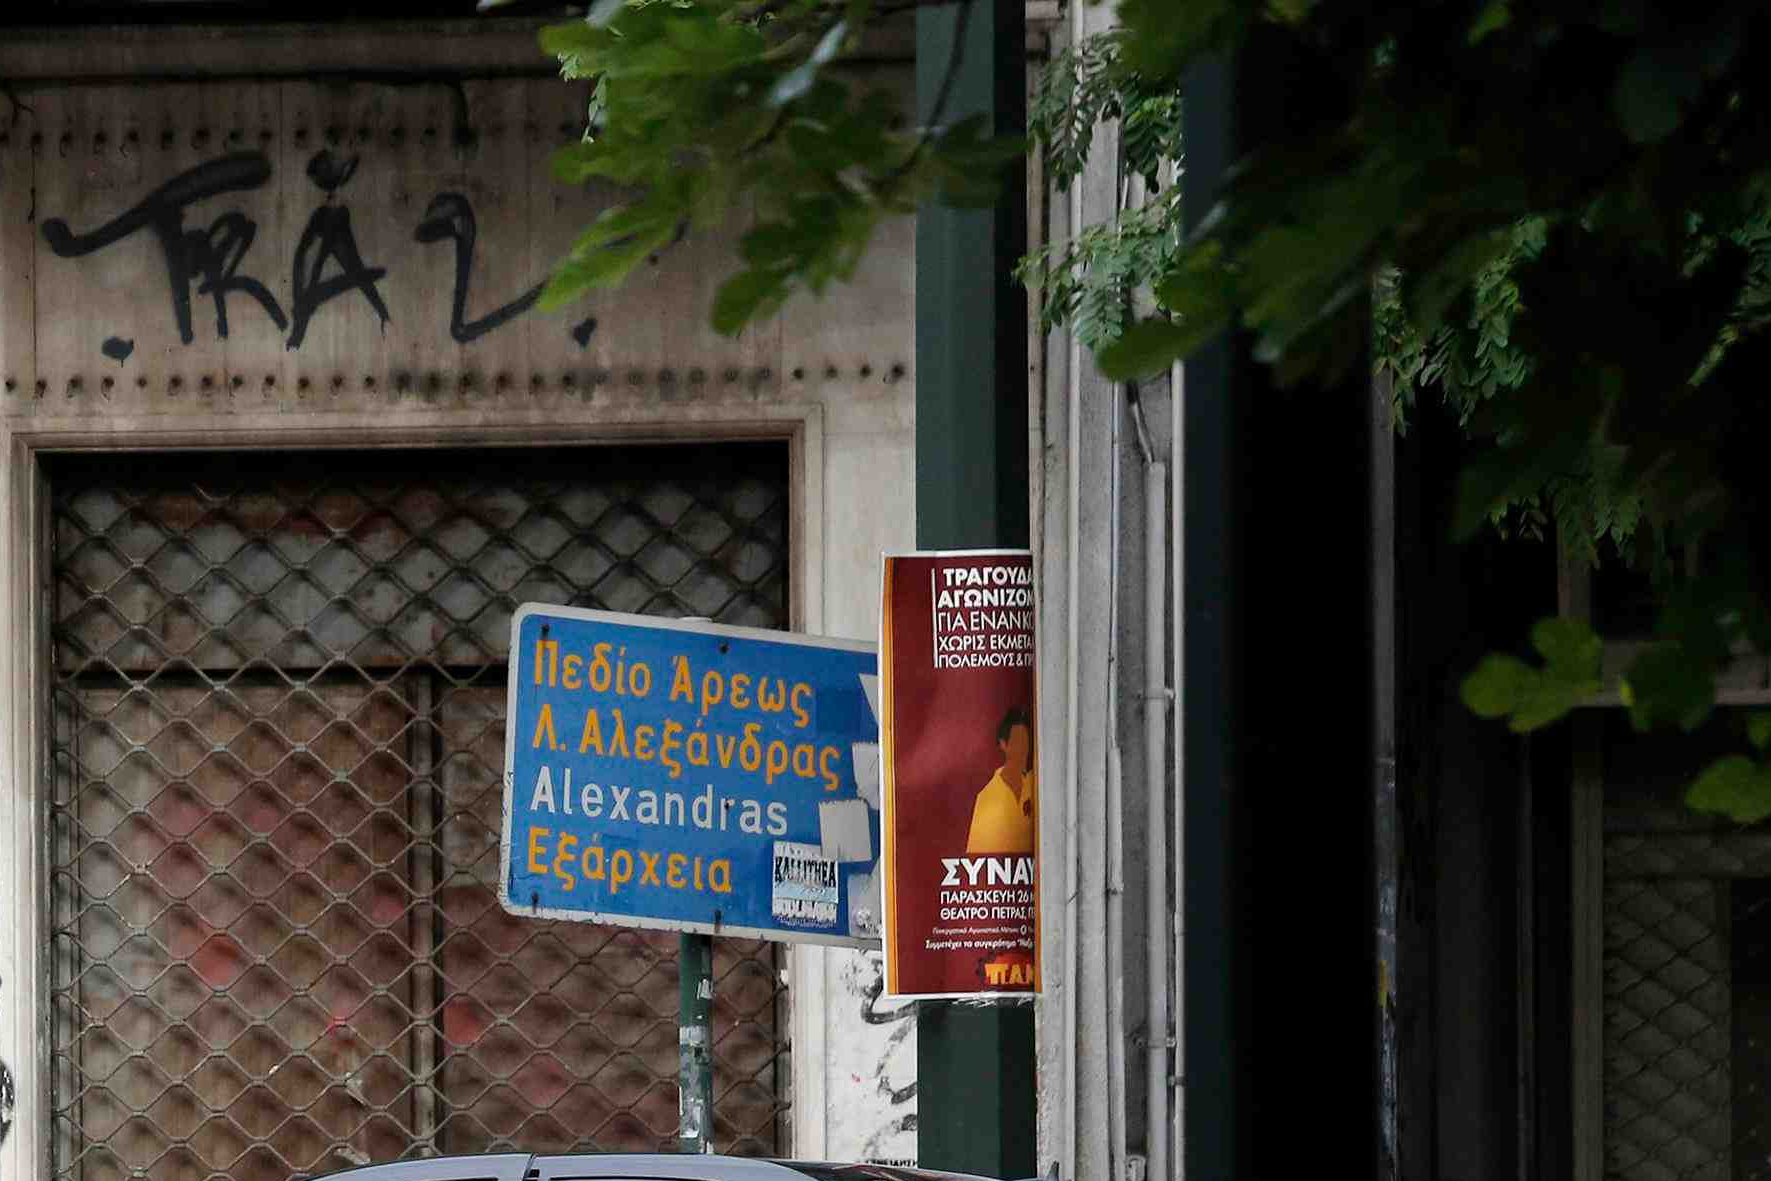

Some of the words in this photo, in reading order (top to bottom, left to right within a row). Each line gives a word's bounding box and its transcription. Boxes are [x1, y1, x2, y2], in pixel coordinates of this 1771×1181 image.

[938, 611, 967, 632] ΓΙΑ
[938, 634, 986, 651] ΧΩΡΙΣ
[990, 634, 1033, 651] ΕΚΜΕΤΑ
[533, 639, 653, 698] Πεδίο
[938, 653, 1014, 669] ΠΟΛΕΜΟΥΣ
[579, 708, 842, 792] Αλεξάνδρας
[530, 765, 790, 836] Alexandras
[528, 826, 733, 895] Εξάρχεια
[940, 889, 1016, 905] ΠΑΡΑΣΚΕΥΗ
[940, 907, 989, 921] ΘΕΑΤΡΟ
